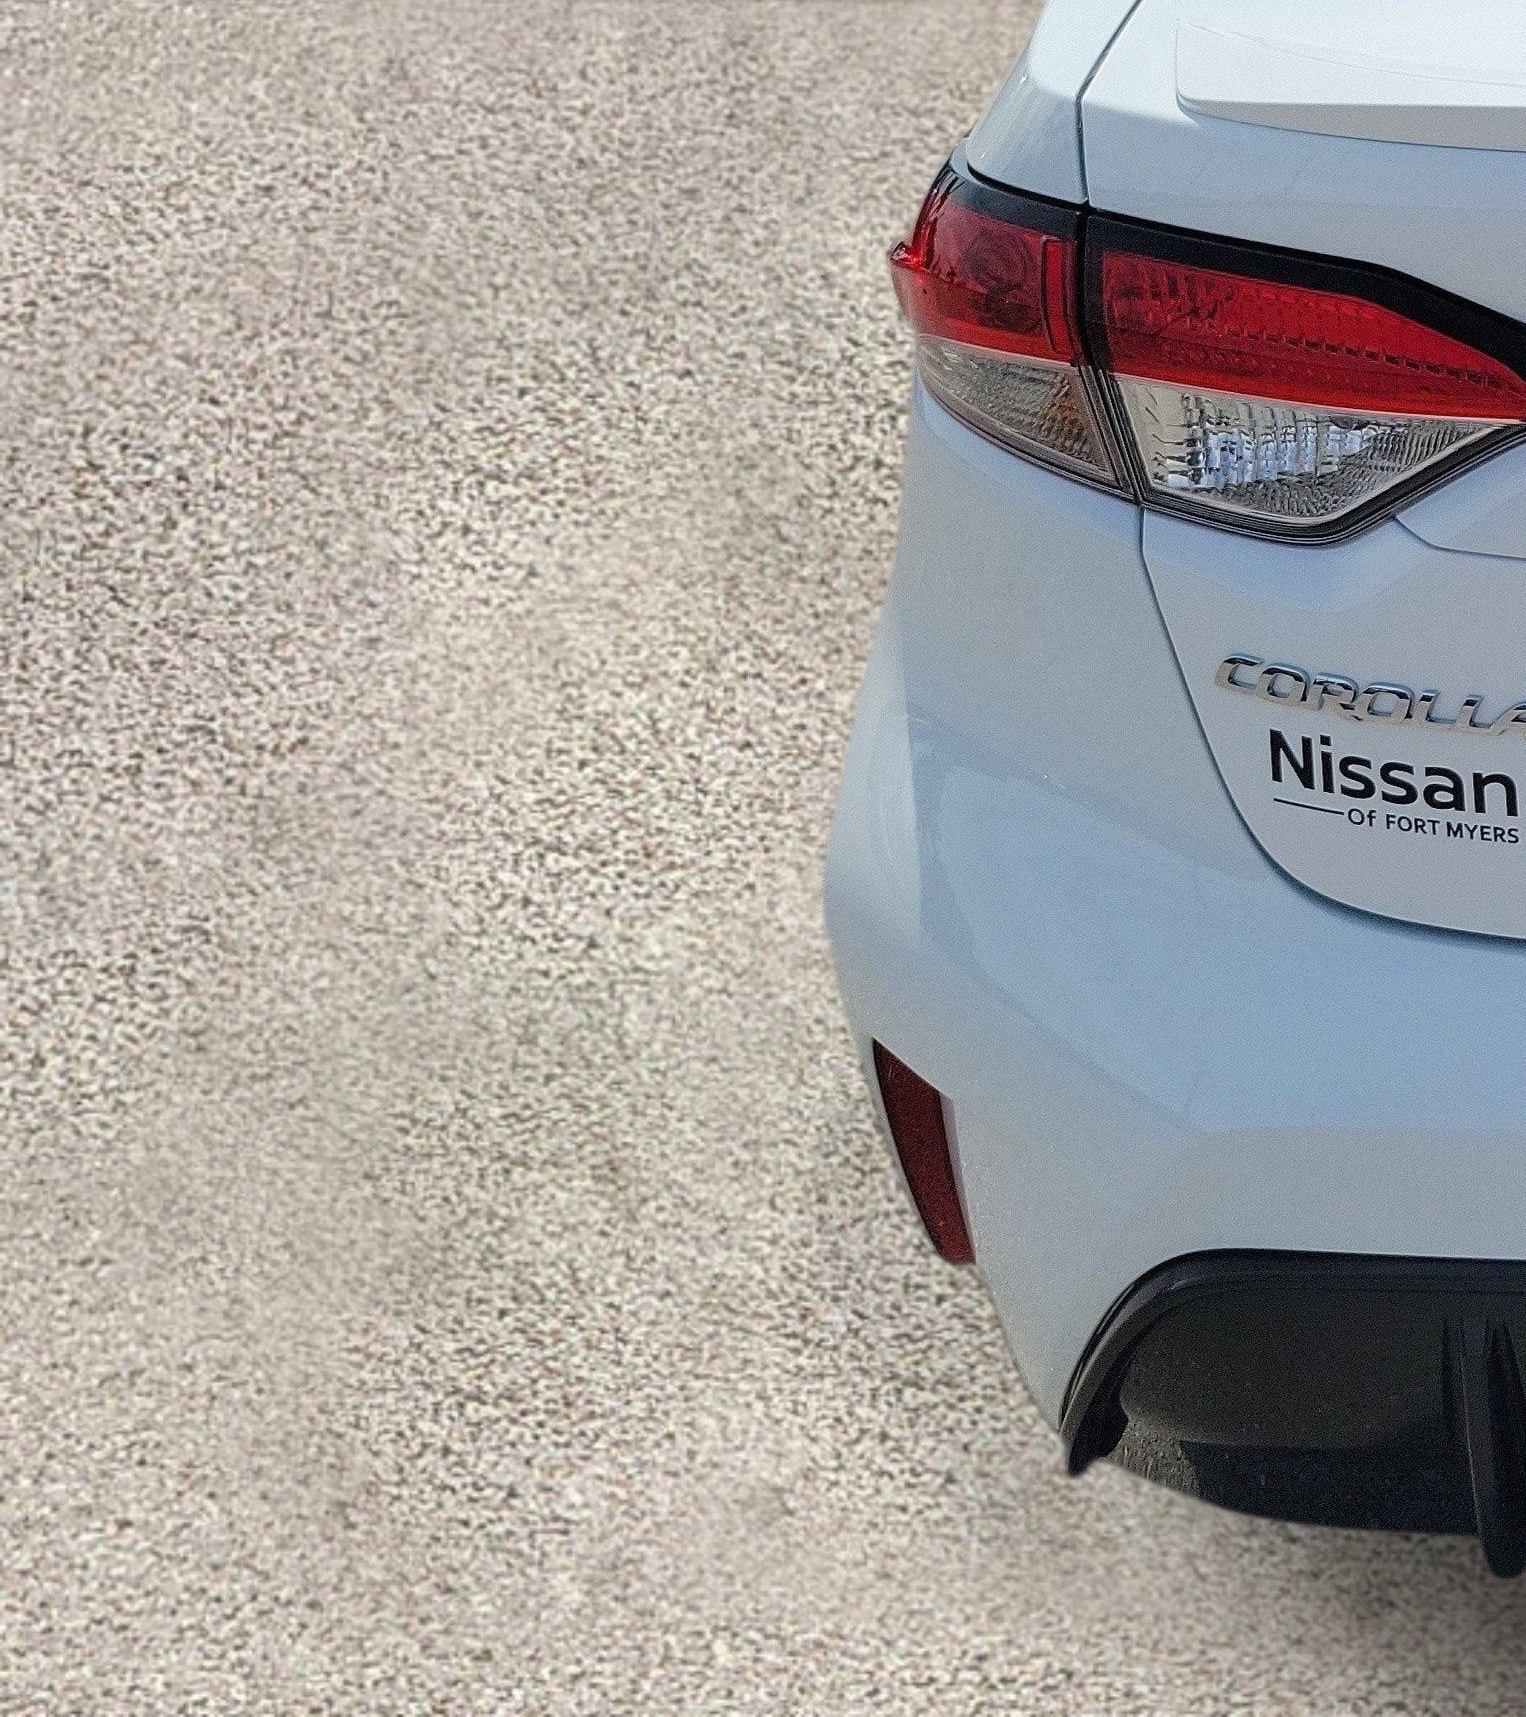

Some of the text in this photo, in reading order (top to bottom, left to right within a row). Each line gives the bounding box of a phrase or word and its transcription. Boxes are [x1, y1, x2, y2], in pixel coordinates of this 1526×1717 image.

[1269, 728, 1519, 817] Nissan
[1347, 808, 1520, 845] Of FORT MYERS
